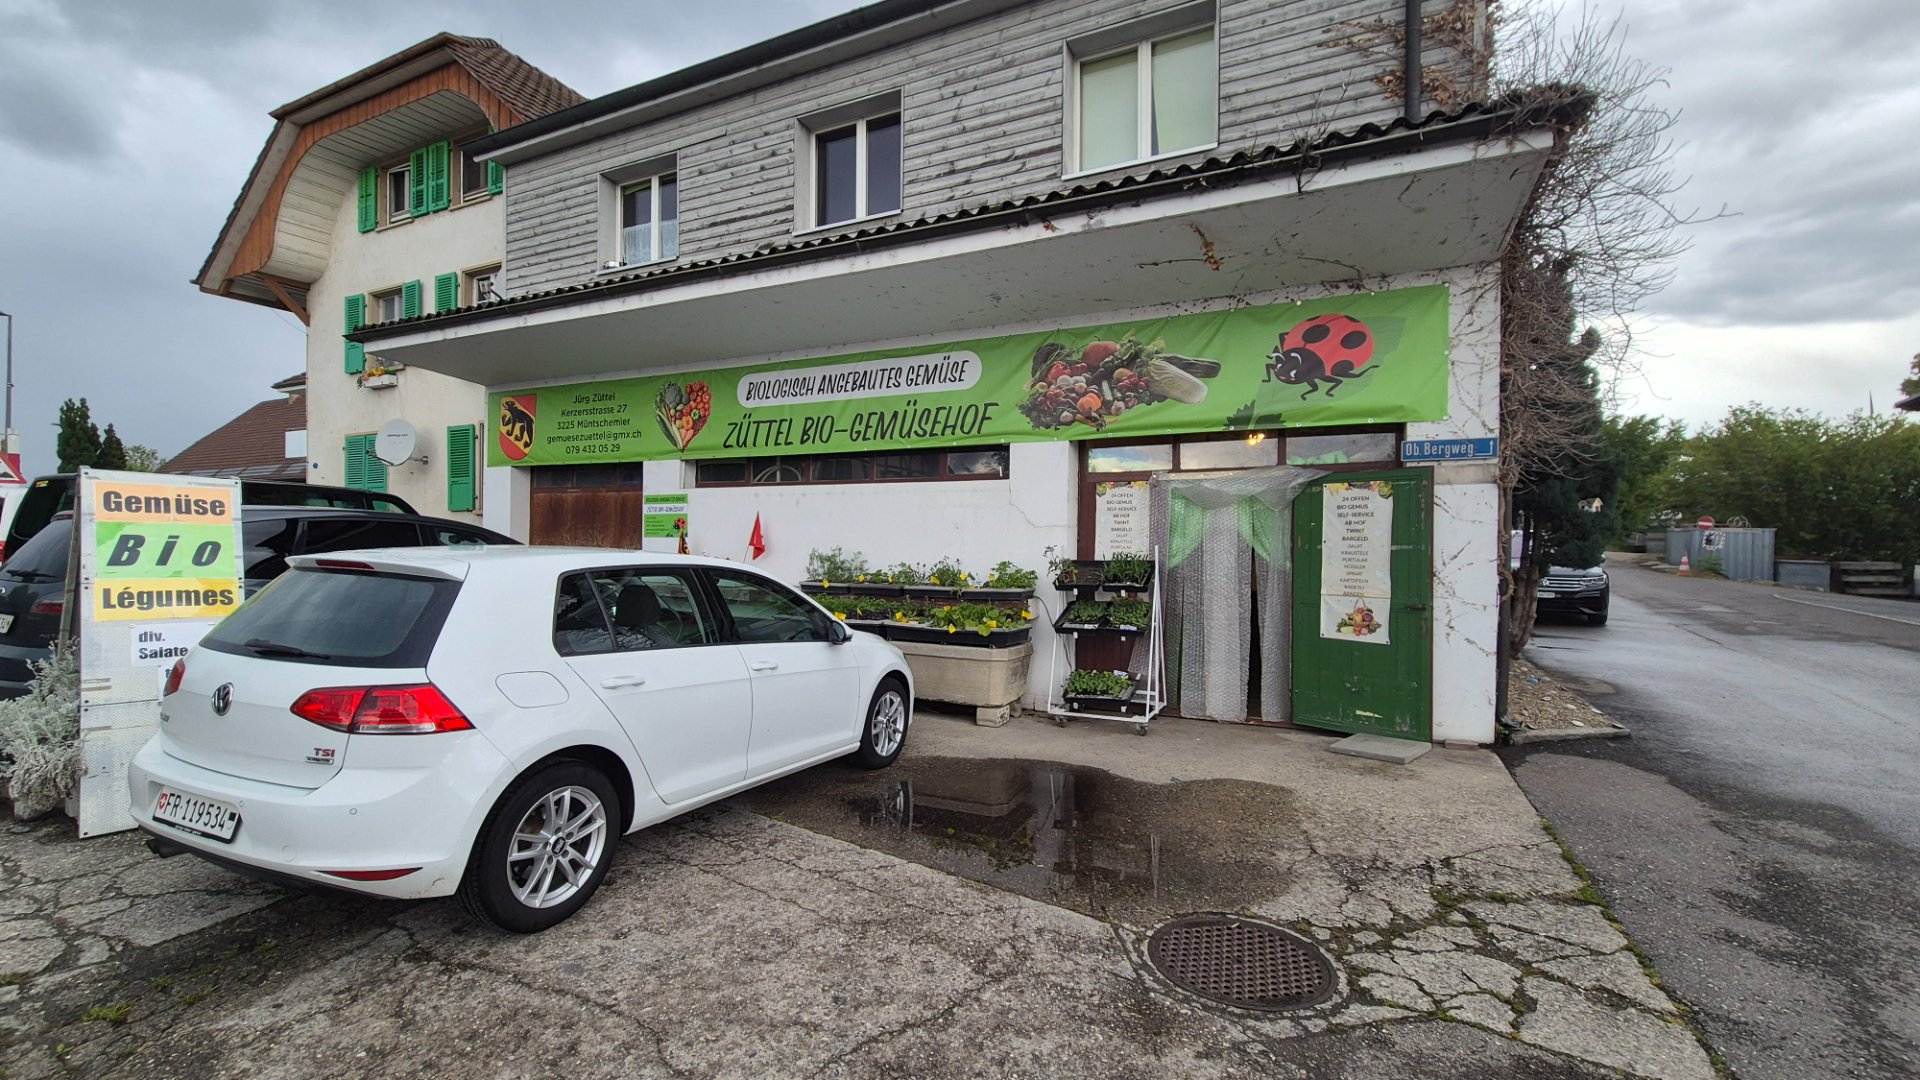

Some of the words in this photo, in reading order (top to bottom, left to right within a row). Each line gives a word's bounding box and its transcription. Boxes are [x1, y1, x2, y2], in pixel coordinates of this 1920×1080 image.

[746, 371, 815, 401] BIOLOGISCH
[817, 363, 901, 396] ANGEBAUTES
[905, 355, 970, 387] GEMÜSE
[573, 394, 590, 404] Jürg
[592, 392, 616, 402] Züttel
[561, 406, 615, 417] Kerzersstrasse
[616, 404, 628, 413] 27
[557, 421, 575, 430] 3225
[577, 418, 631, 429] Müntschemier
[723, 413, 794, 449] ZÜTTEL
[799, 400, 999, 445] BIO-GEMÜSEHOF
[546, 429, 642, 444] gemuesezuettel@gmx.ch
[565, 445, 580, 454] 079
[582, 444, 597, 453] 432
[598, 443, 609, 453] 05
[611, 443, 621, 453] 29
[1405, 442, 1421, 456] Ob.
[1424, 442, 1474, 458] Bergweg
[102, 490, 226, 516] Gemüse
[106, 534, 222, 567] Bio
[102, 587, 234, 611] Légumes
[138, 631, 166, 643] div.
[313, 747, 335, 757] TSI
